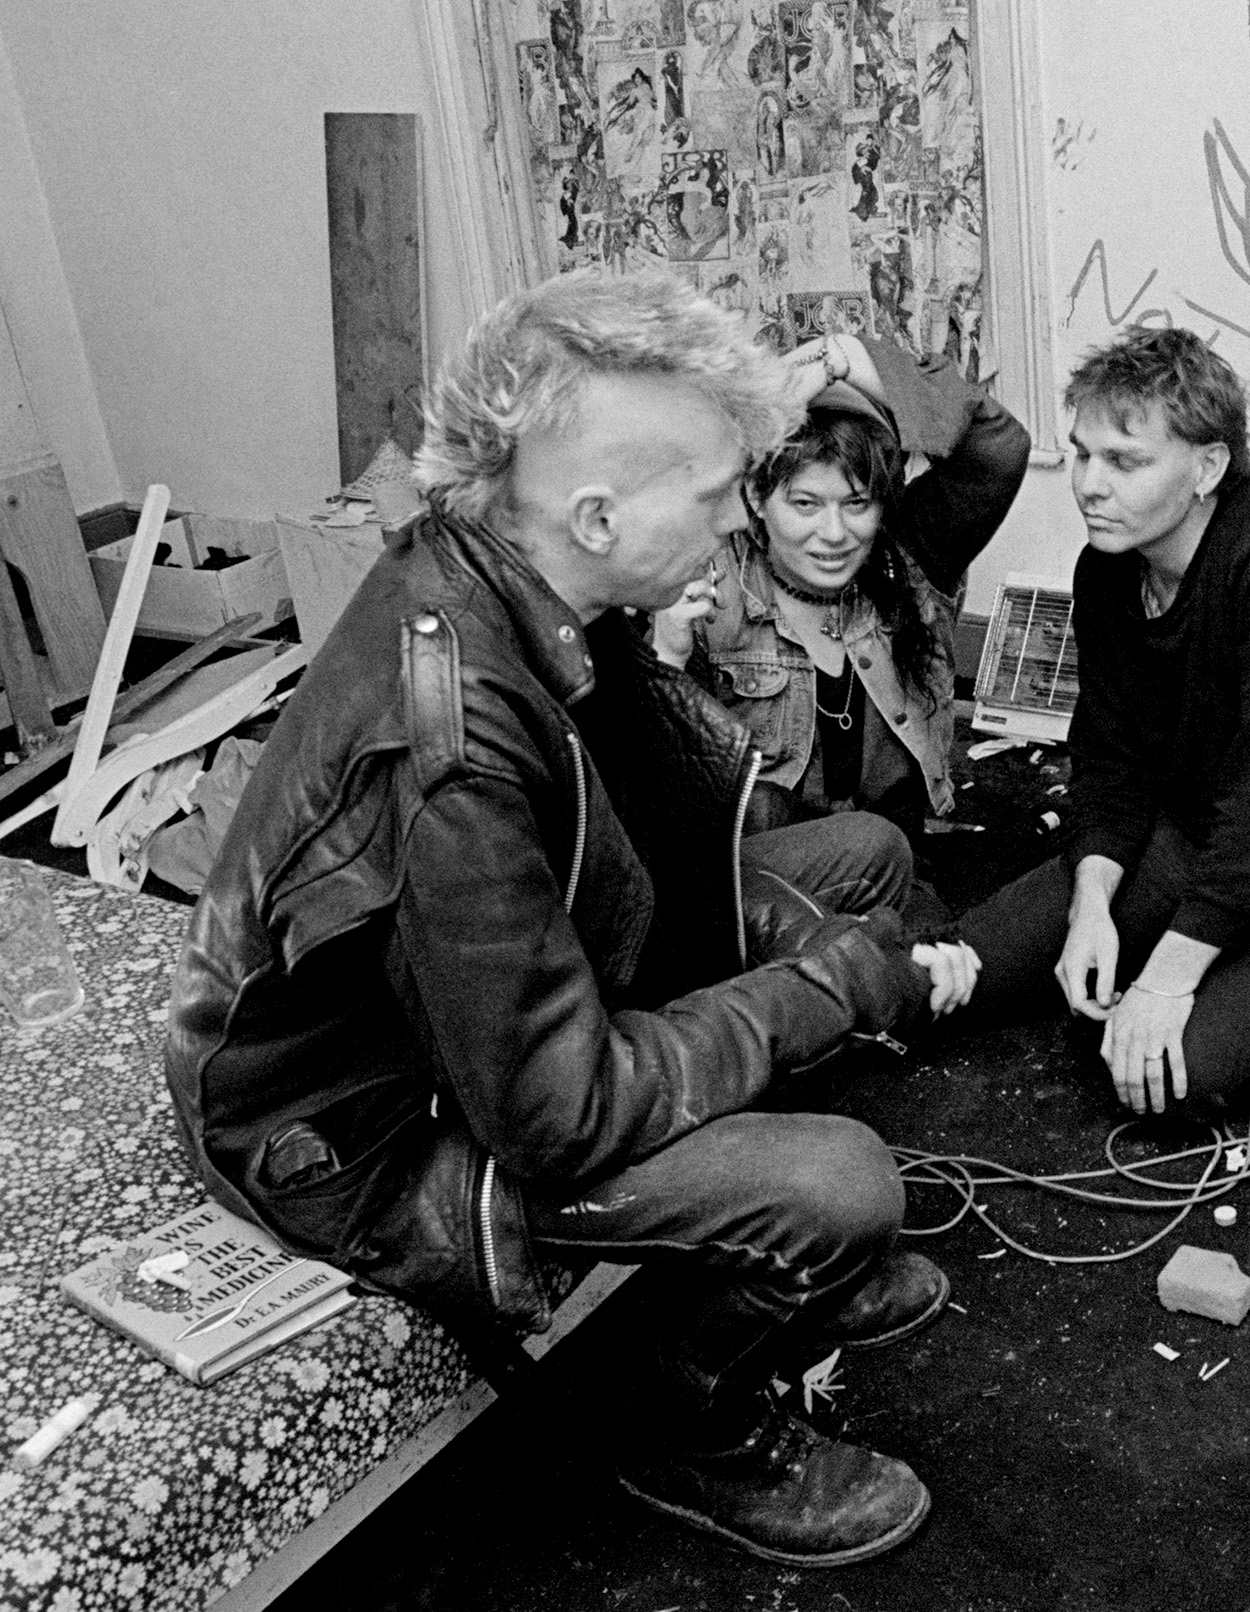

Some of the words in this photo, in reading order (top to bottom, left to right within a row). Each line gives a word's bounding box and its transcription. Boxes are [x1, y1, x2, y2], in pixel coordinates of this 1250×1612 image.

[155, 1211, 221, 1243] WINE
[193, 1238, 245, 1265] THE
[209, 1245, 267, 1279] BEST
[280, 1273, 330, 1303] MAURY
